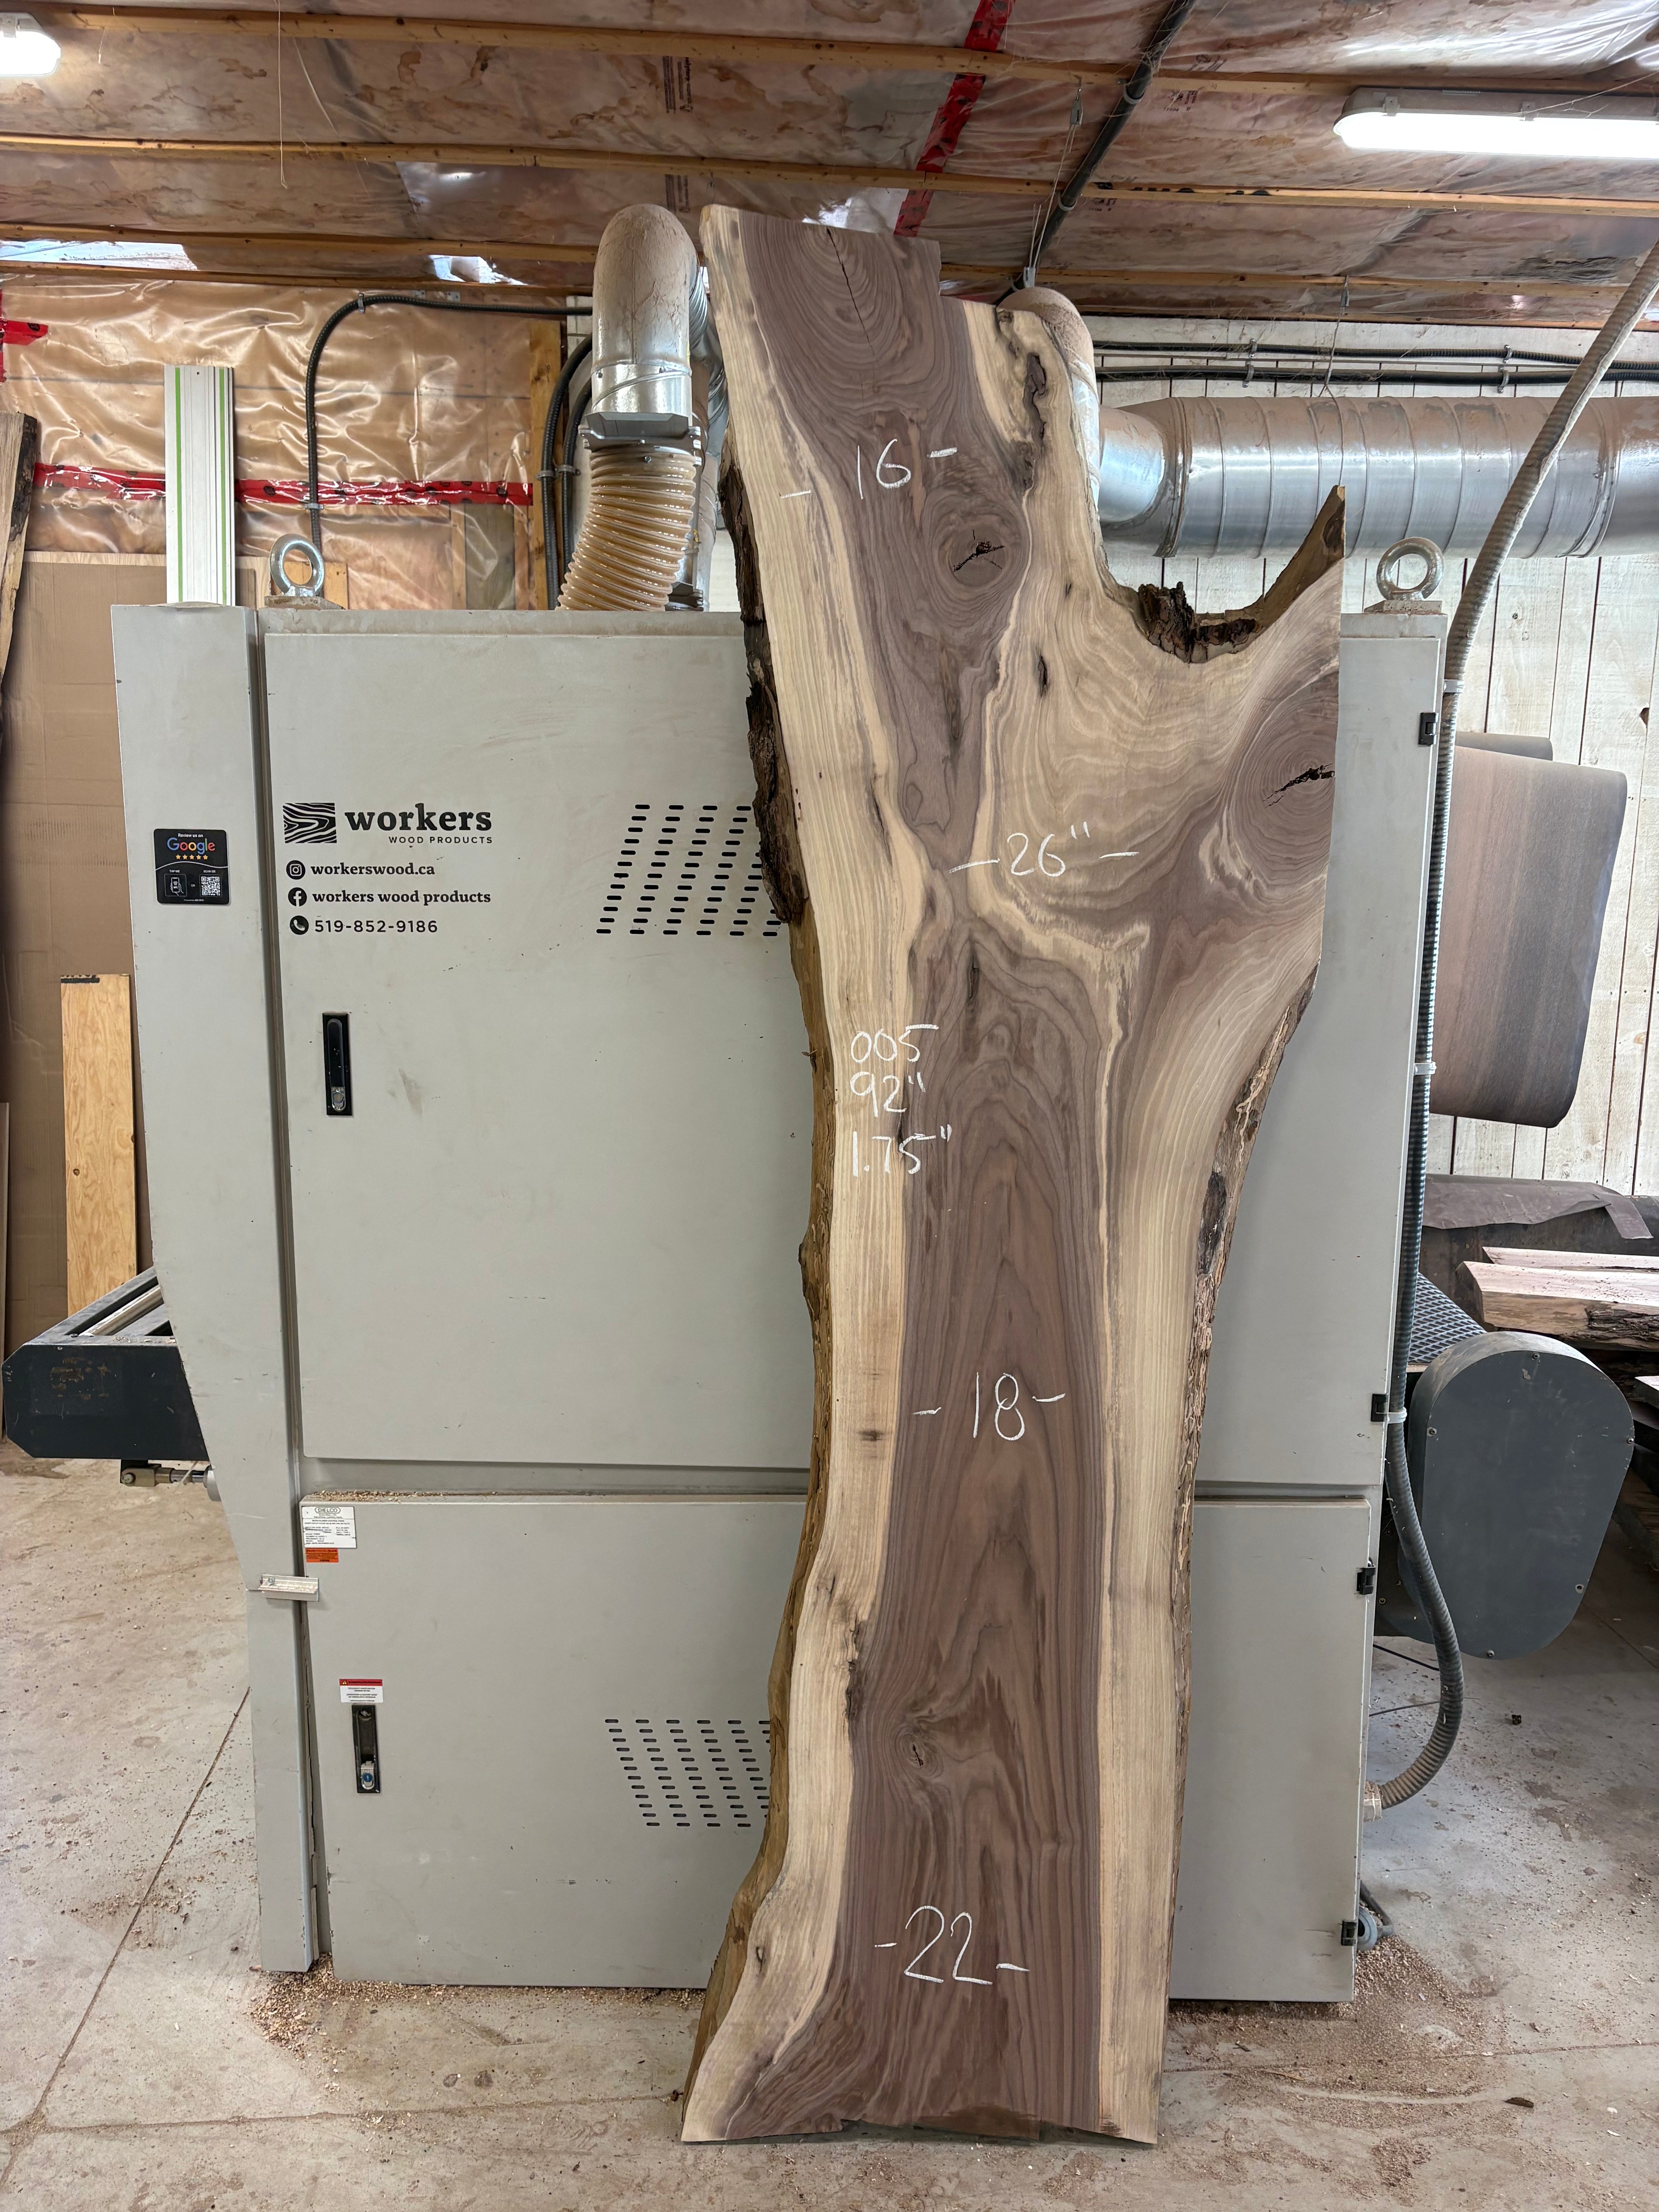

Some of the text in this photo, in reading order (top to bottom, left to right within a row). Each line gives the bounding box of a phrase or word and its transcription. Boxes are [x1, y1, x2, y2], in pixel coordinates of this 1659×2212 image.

[344, 803, 492, 831] workers
[167, 837, 215, 854] Google
[311, 862, 435, 875] workerswood.ca
[313, 890, 491, 906] workers wood products
[315, 920, 438, 933] 519-852-9186
[851, 1024, 939, 1063] 005
[850, 1071, 926, 1117] 92"
